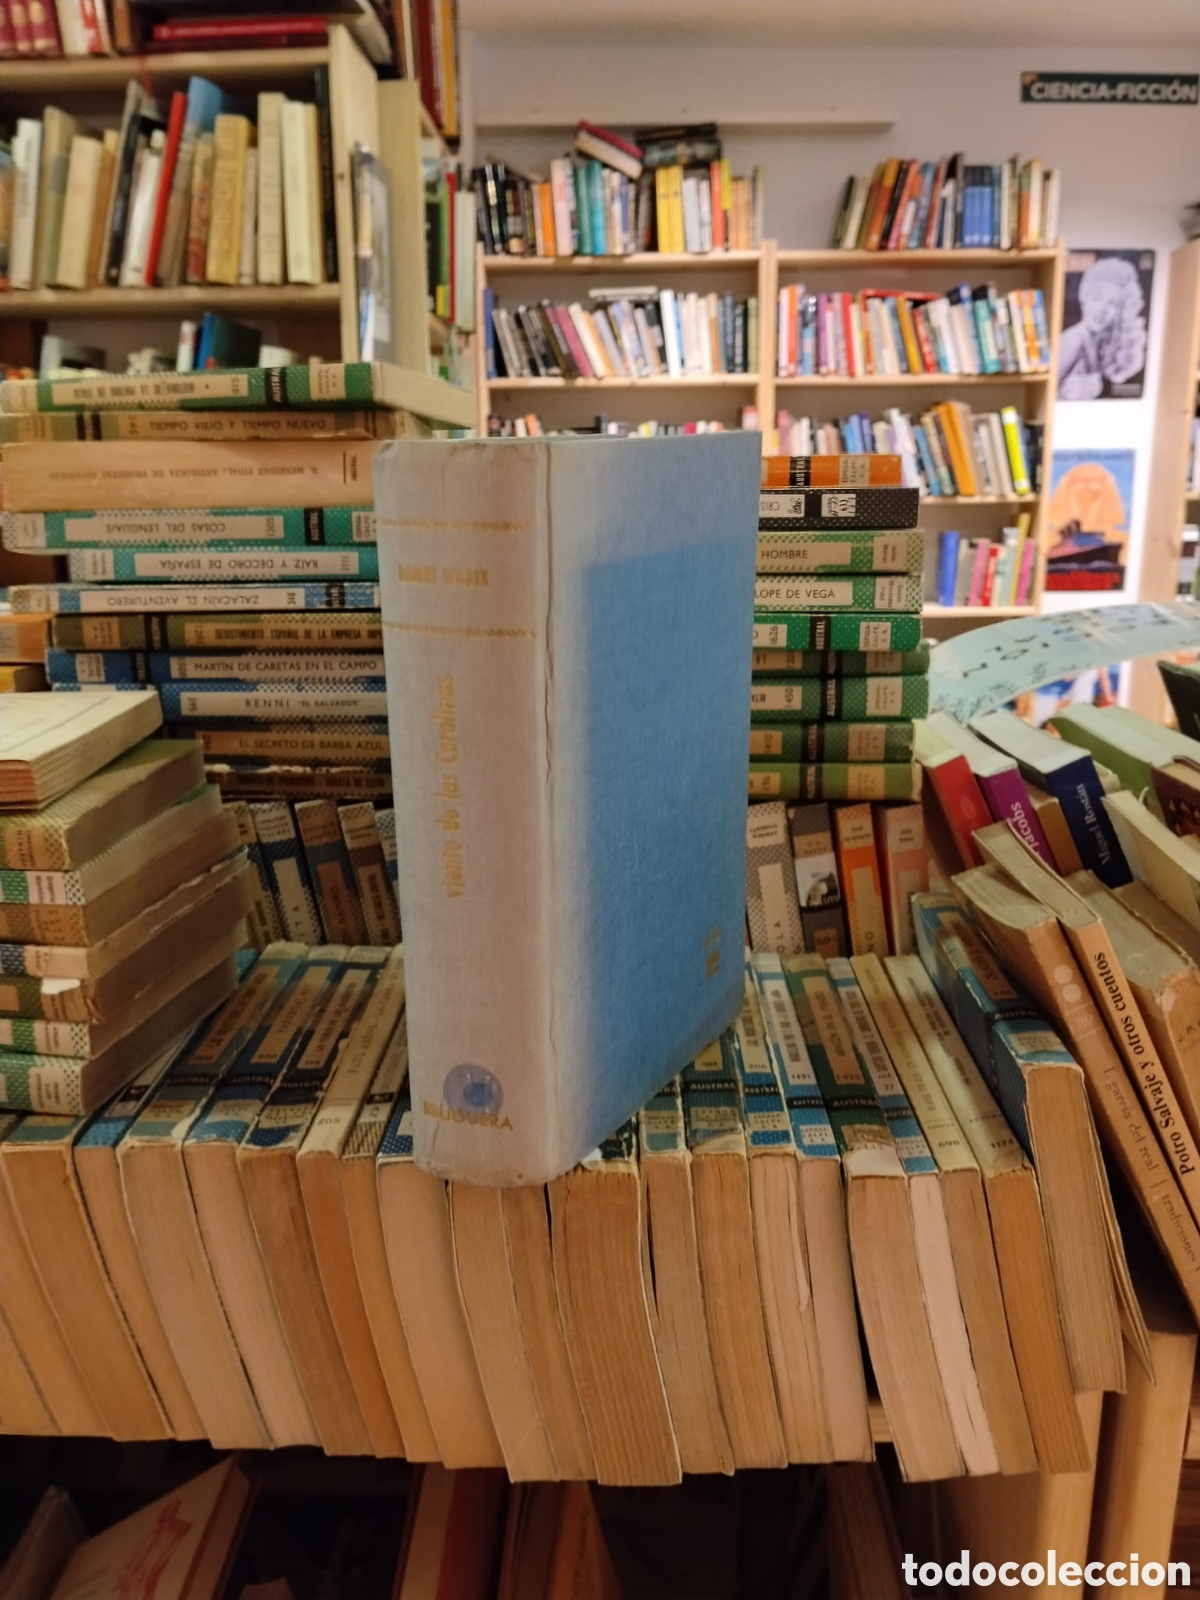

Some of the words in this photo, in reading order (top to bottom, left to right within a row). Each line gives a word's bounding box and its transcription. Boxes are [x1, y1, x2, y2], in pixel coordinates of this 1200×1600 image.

[1030, 79, 1198, 101] CIENCIA-FICCIÓN
[150, 419, 187, 431] TIEMPO
[194, 419, 223, 431] VIEJO
[229, 419, 236, 430] Y
[243, 419, 281, 430] TIEMPO
[286, 418, 326, 430] NUEVO
[796, 456, 805, 487] AUSTRAL
[105, 523, 159, 534] LENGUAJE
[167, 523, 185, 533] DEL
[192, 522, 226, 533] COSAS
[761, 549, 808, 559] HOMBRE
[160, 558, 201, 571] ESPAÑA
[208, 559, 222, 569] DE
[230, 559, 273, 569] DECORO
[281, 559, 287, 569] Y
[294, 558, 318, 570] RAÍZ
[755, 589, 781, 599] LOPE
[786, 589, 801, 598] DE
[805, 588, 835, 598] VEGA
[107, 596, 178, 606] AVENTURERO
[768, 625, 778, 646] 1626
[194, 660, 235, 672] MARTÍN
[239, 661, 252, 671] DE
[256, 661, 301, 671] CARETAS
[305, 660, 320, 670] EN
[324, 660, 335, 670] EL
[339, 659, 377, 670] CAMPO
[245, 699, 291, 708] RENNI
[431, 675, 458, 766] Carolinas
[254, 739, 299, 749] SECRETO
[305, 739, 316, 749] DE
[319, 739, 352, 750] BARBA
[356, 740, 383, 750] AZUL
[435, 773, 460, 801] las
[436, 809, 460, 832] de
[1011, 801, 1041, 852] Jacobs
[1094, 951, 1127, 1013] cuentos
[1120, 1016, 1146, 1056] otros
[1138, 1060, 1155, 1071] y
[690, 1083, 736, 1091] AUSTRAL
[1144, 1072, 1176, 1130] Salvaje
[316, 1117, 341, 1126] 205
[1128, 1121, 1145, 1144] del
[1140, 1146, 1160, 1172] real
[1166, 1132, 1196, 1176] Potro
[1161, 1192, 1196, 1265] tradiciones
